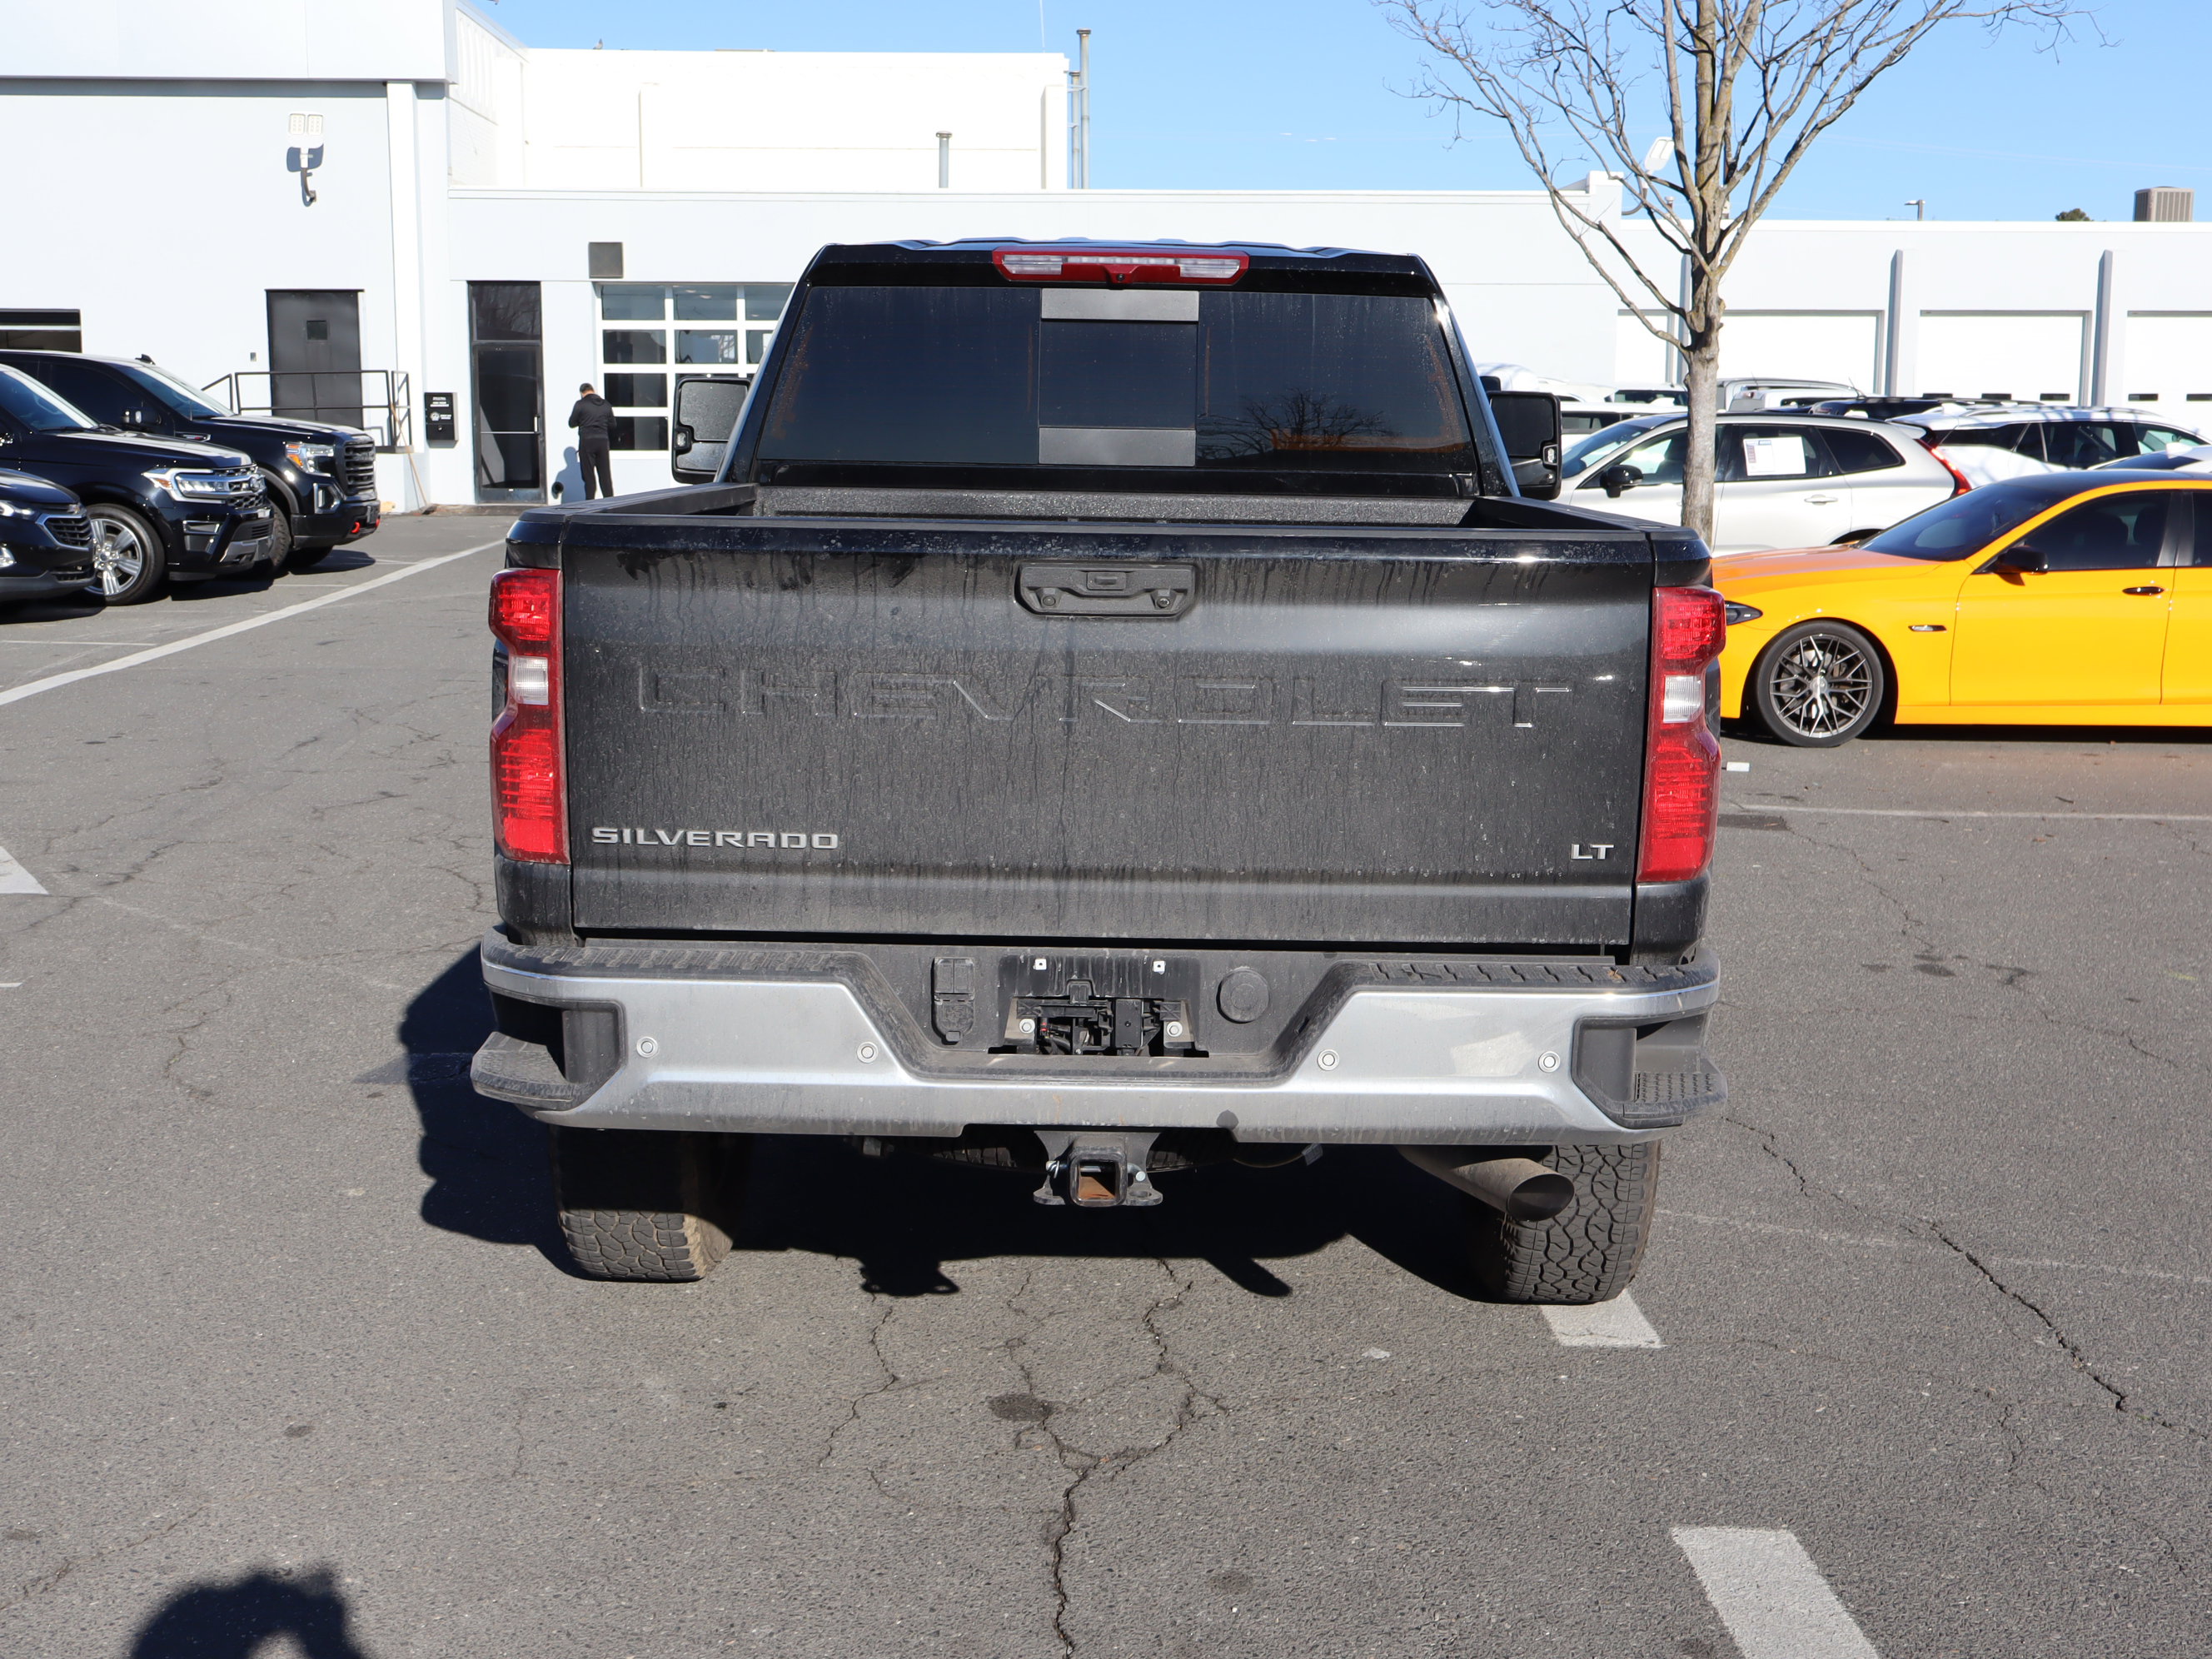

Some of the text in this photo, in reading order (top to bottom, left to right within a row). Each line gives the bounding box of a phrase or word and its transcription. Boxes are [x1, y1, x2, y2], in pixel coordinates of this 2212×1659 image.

[636, 665, 1576, 730] CHEVROLET
[591, 827, 839, 849] SILVERADO
[1571, 844, 1614, 859] LT
